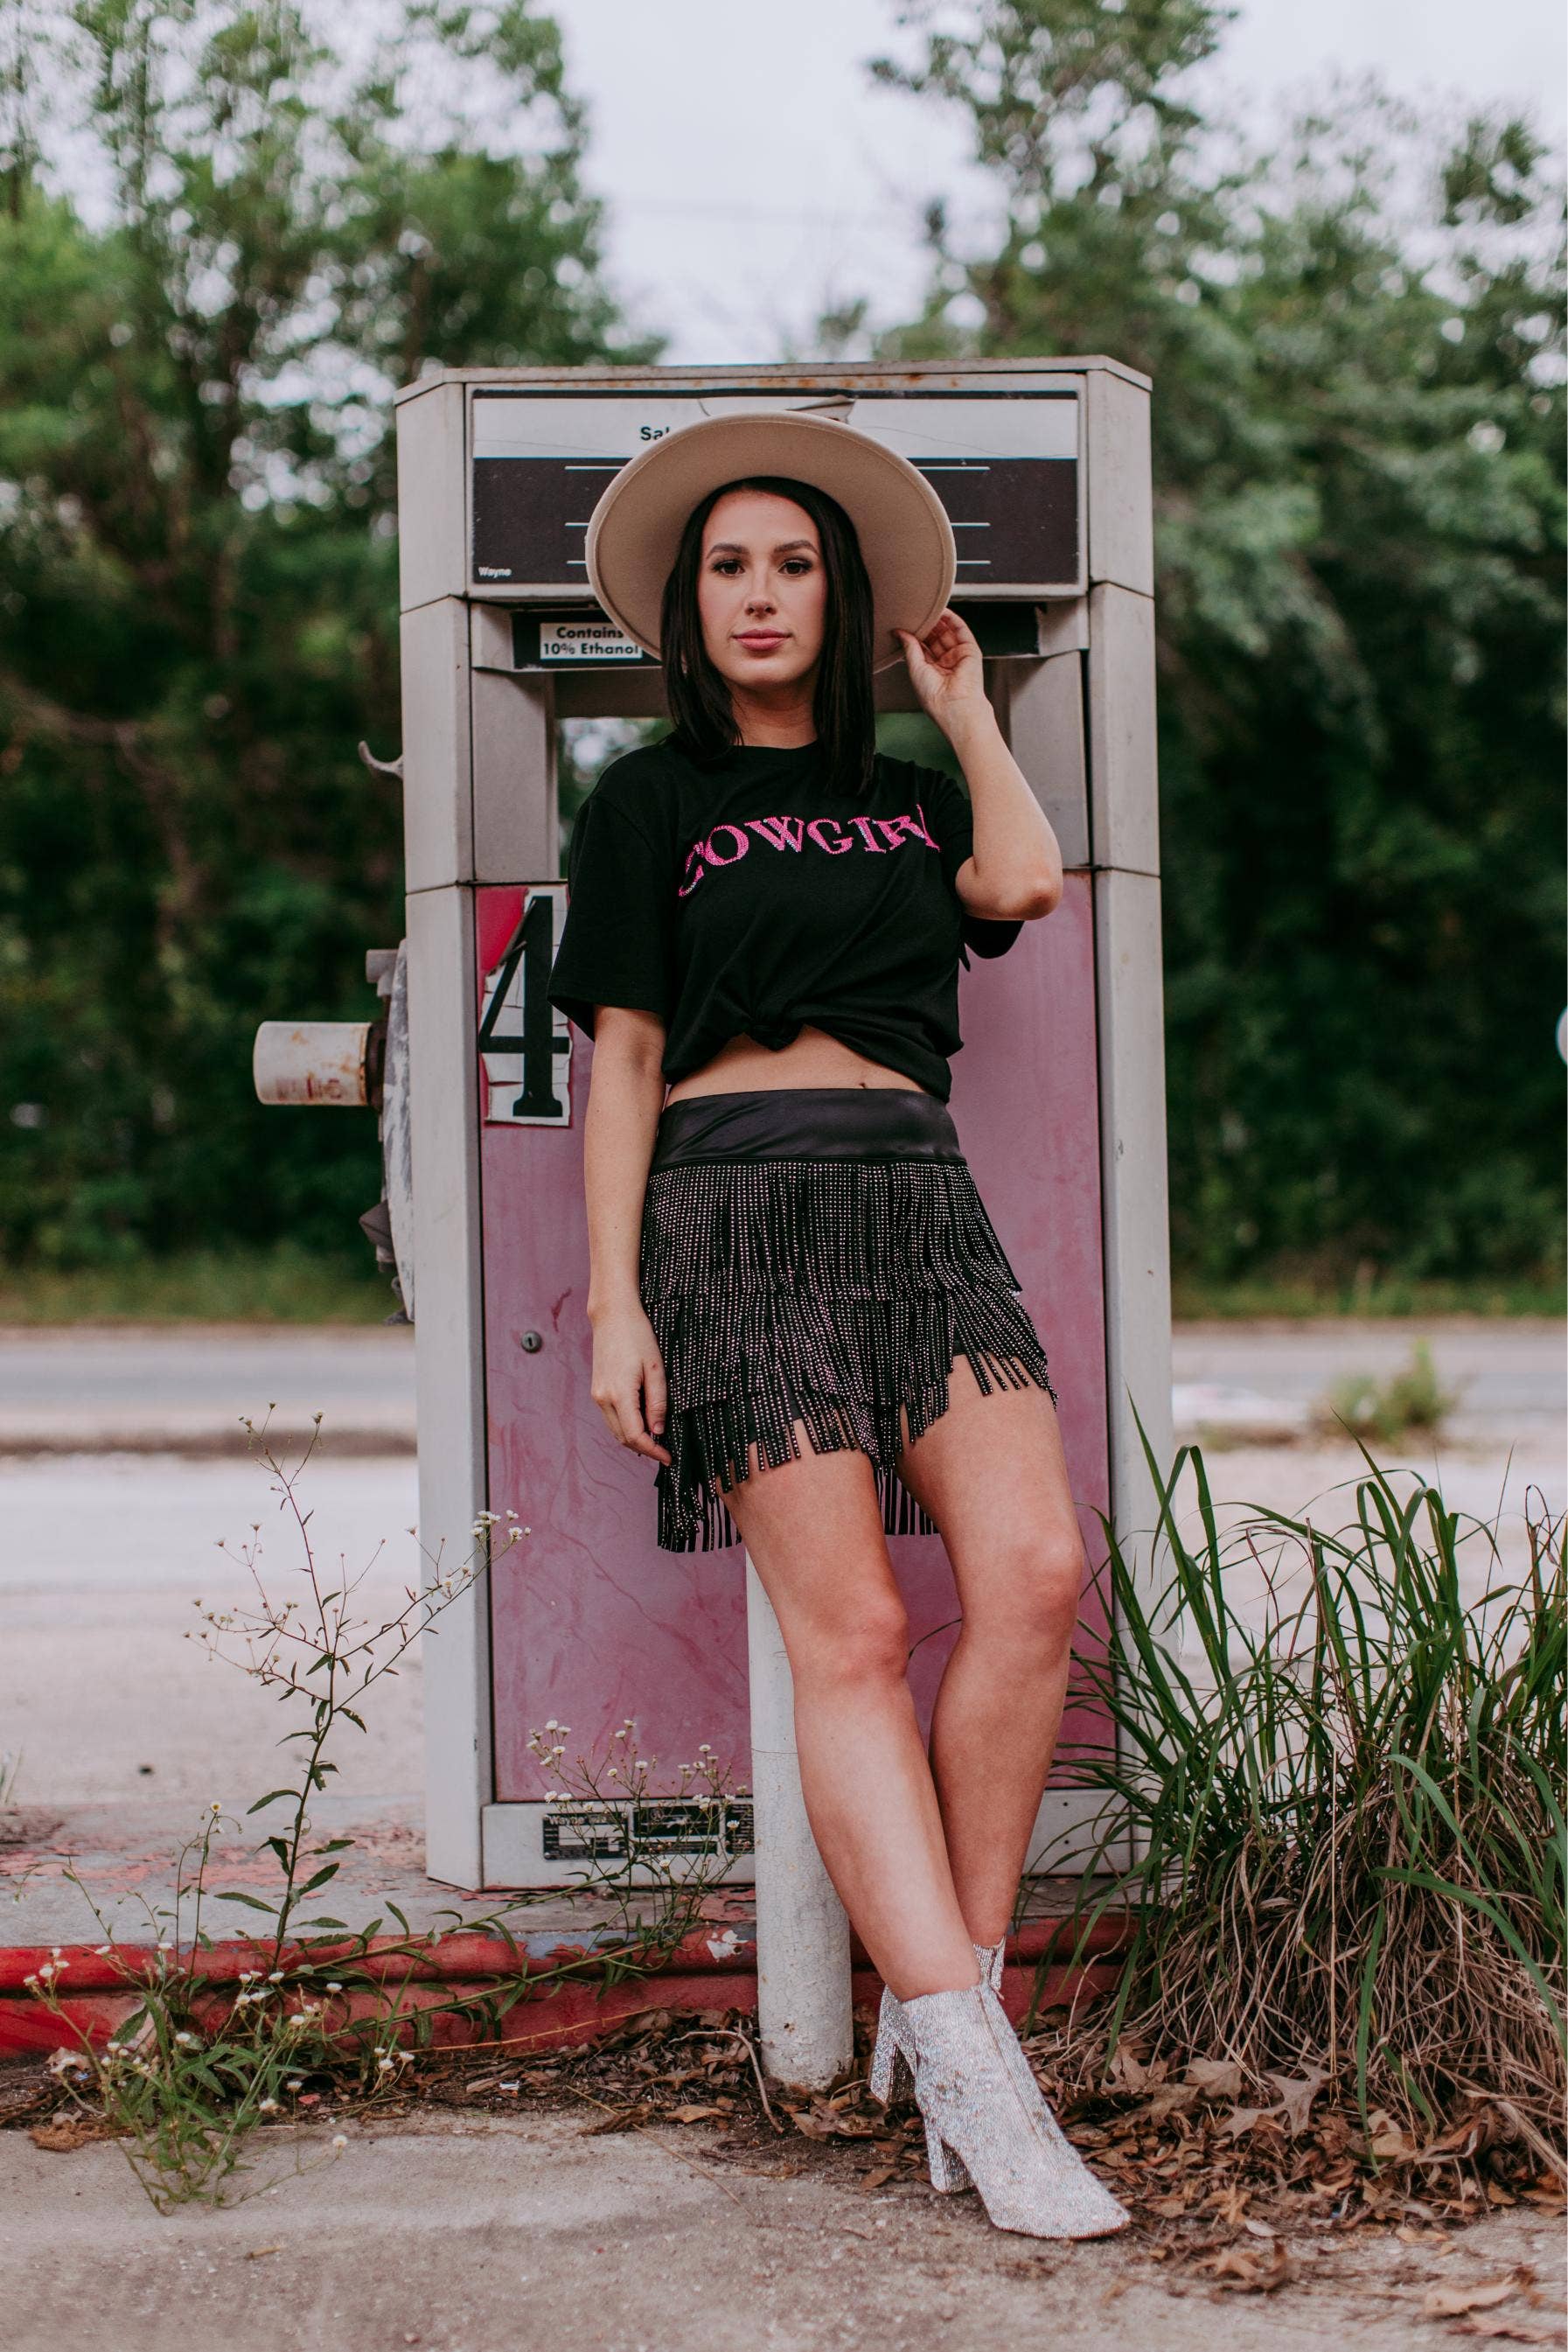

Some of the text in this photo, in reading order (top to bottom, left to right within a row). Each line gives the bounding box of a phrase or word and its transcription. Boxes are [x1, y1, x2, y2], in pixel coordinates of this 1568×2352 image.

[556, 626, 624, 639] Contains
[543, 642, 638, 654] 10% Ethanol
[478, 895, 569, 1118] 4
